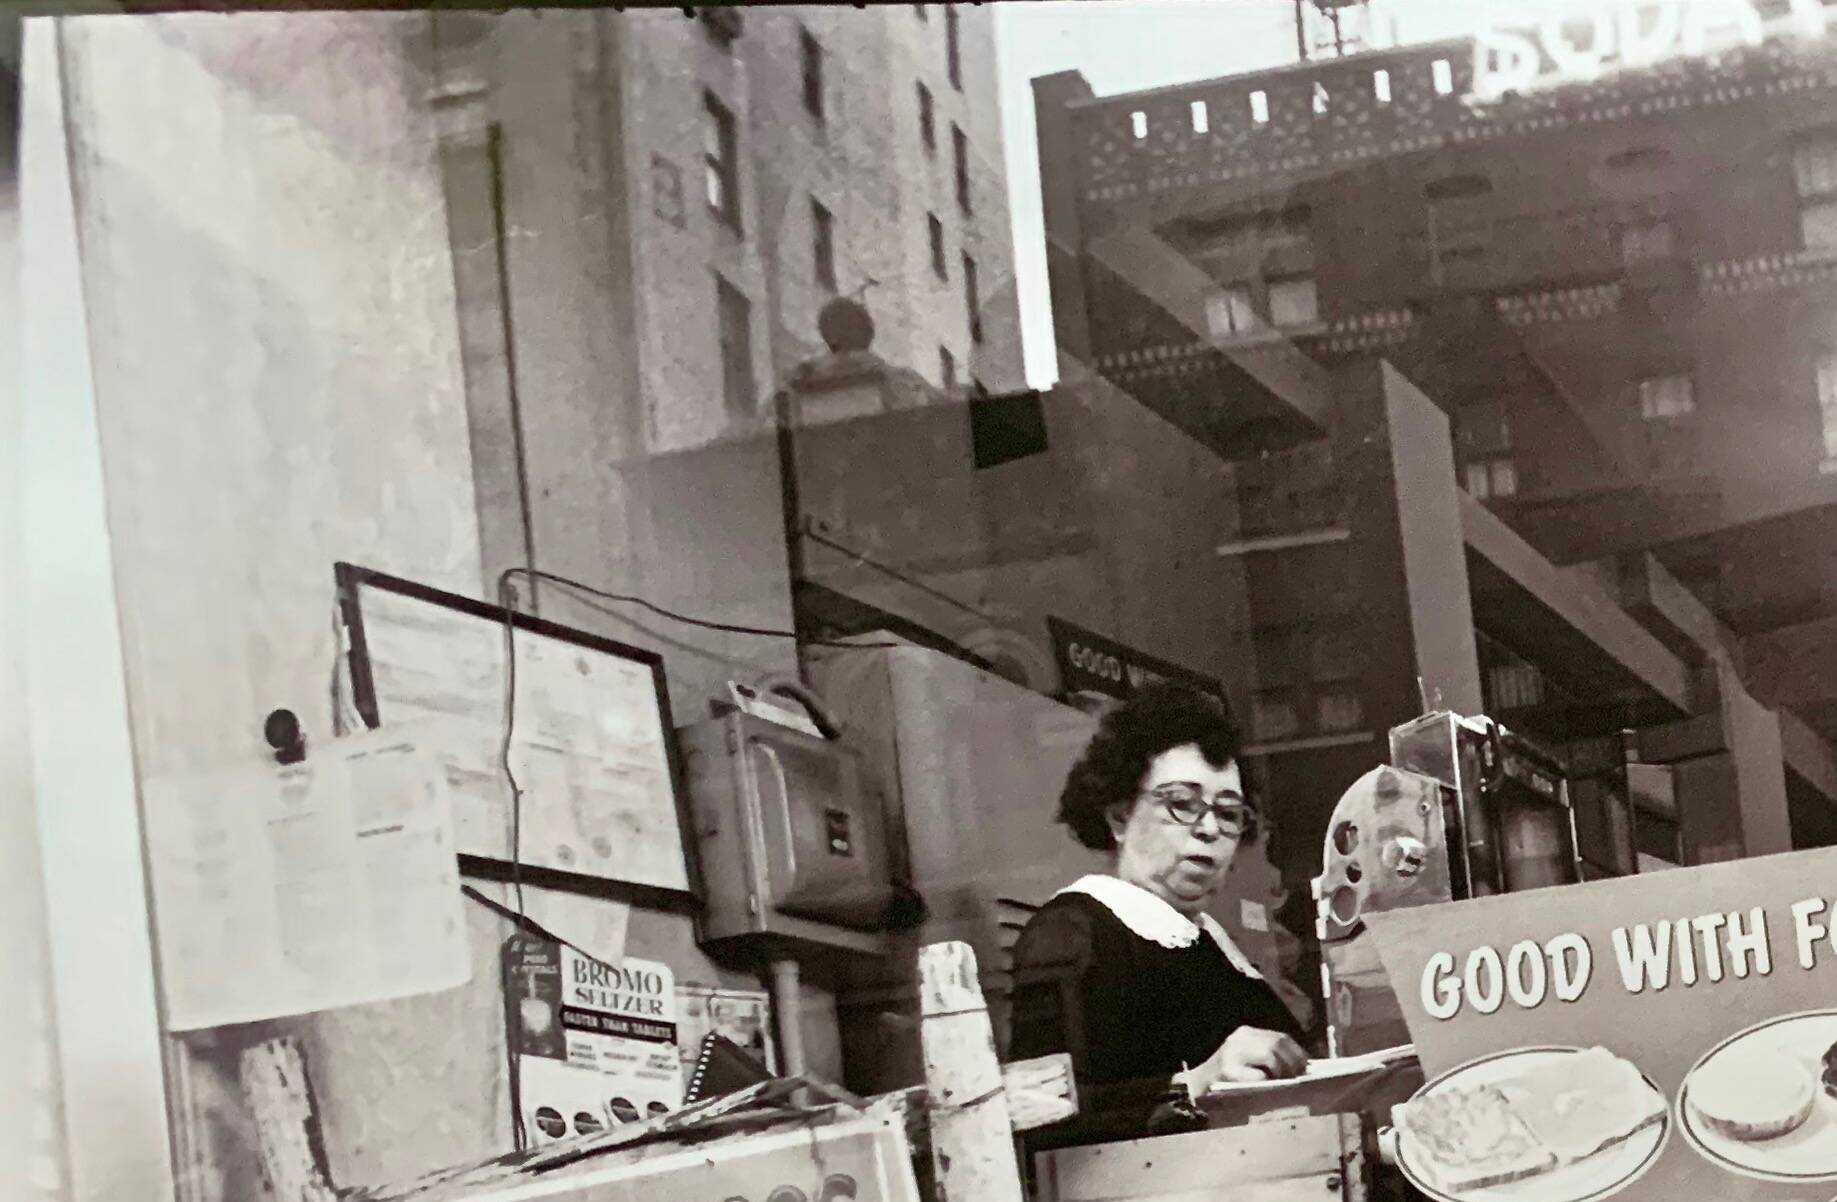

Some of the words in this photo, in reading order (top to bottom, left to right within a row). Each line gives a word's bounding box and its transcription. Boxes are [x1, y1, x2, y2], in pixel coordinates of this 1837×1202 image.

[1068, 641, 1122, 683] GOOD
[573, 958, 663, 996] BROMO
[1419, 931, 1593, 1020] GOOD
[1610, 905, 1772, 995] WITH
[575, 986, 665, 1016] SELTZER
